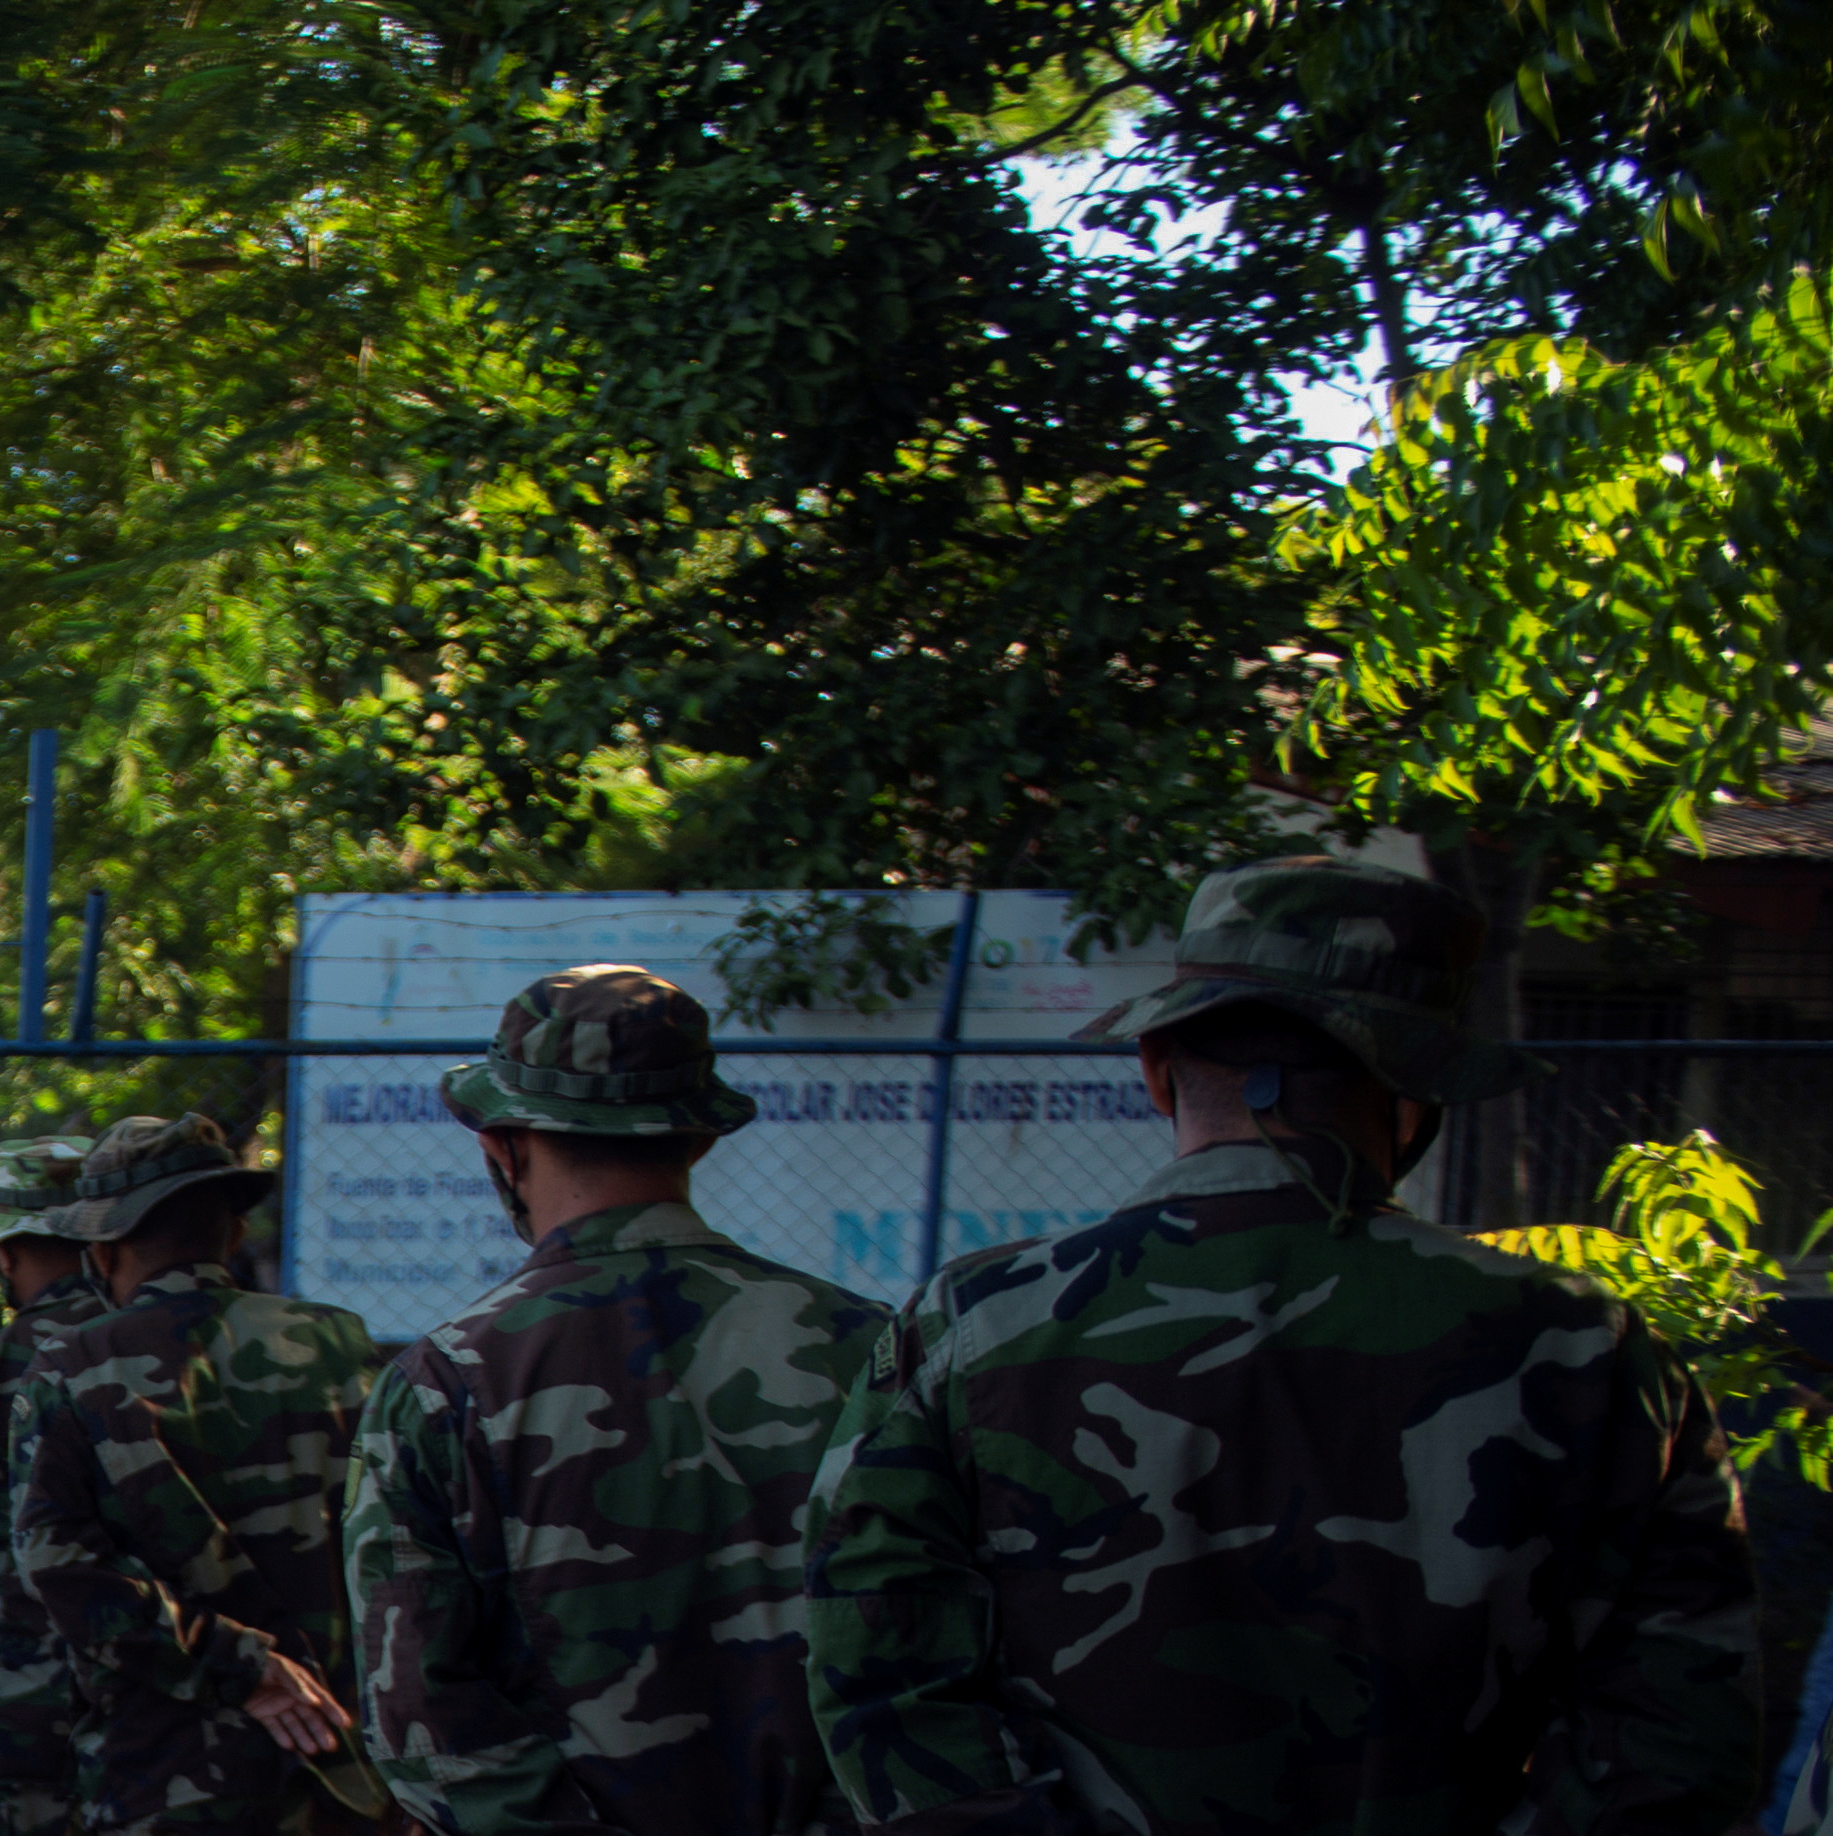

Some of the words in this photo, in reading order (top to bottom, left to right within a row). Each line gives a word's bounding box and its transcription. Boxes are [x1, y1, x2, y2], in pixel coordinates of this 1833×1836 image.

[322, 1083, 452, 1123] MEJORAM
[841, 1080, 911, 1122] JOSE
[918, 1080, 1035, 1122] DLORES
[1045, 1080, 1162, 1122] ESTRAD
